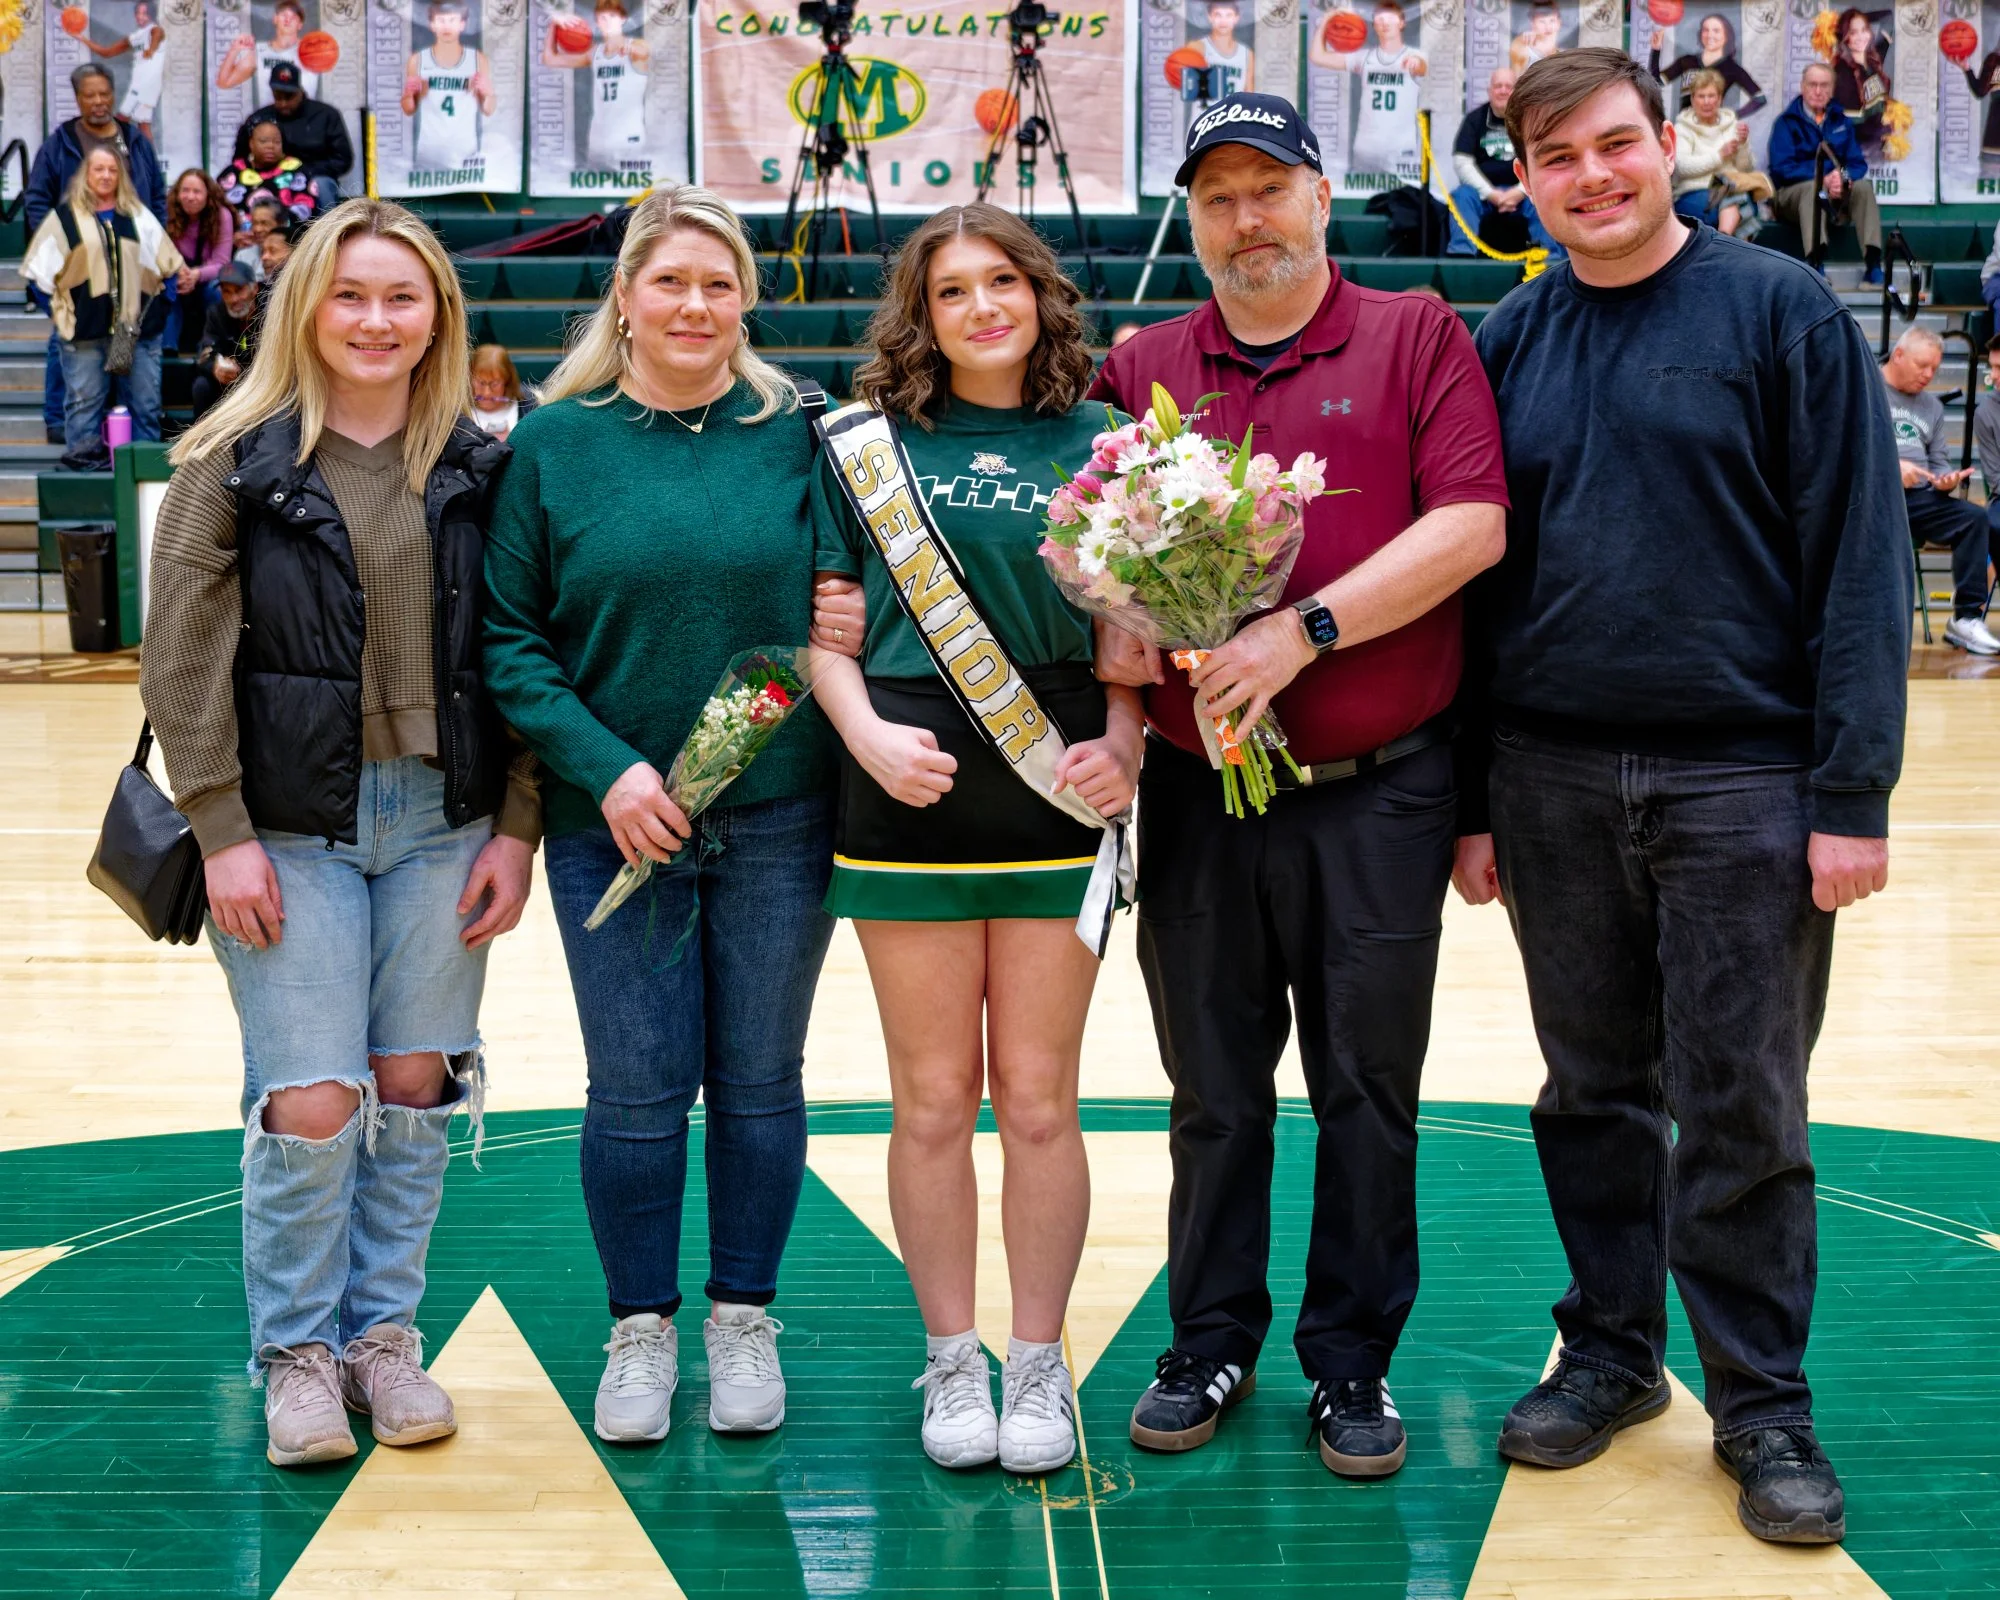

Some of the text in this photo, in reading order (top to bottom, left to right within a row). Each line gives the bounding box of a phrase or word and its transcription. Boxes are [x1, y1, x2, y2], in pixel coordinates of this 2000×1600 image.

[1474, 16, 1499, 66] BEES
[428, 77, 469, 91] MEDINA
[1367, 72, 1404, 86] MEDINA
[602, 83, 618, 102] 13
[1371, 90, 1396, 111] 20
[441, 96, 455, 117] 4
[1190, 104, 1287, 150] Titleist
[408, 168, 485, 188] HARUBIN
[570, 171, 654, 189] KOPKAS
[841, 438, 1049, 764] SENIOR
